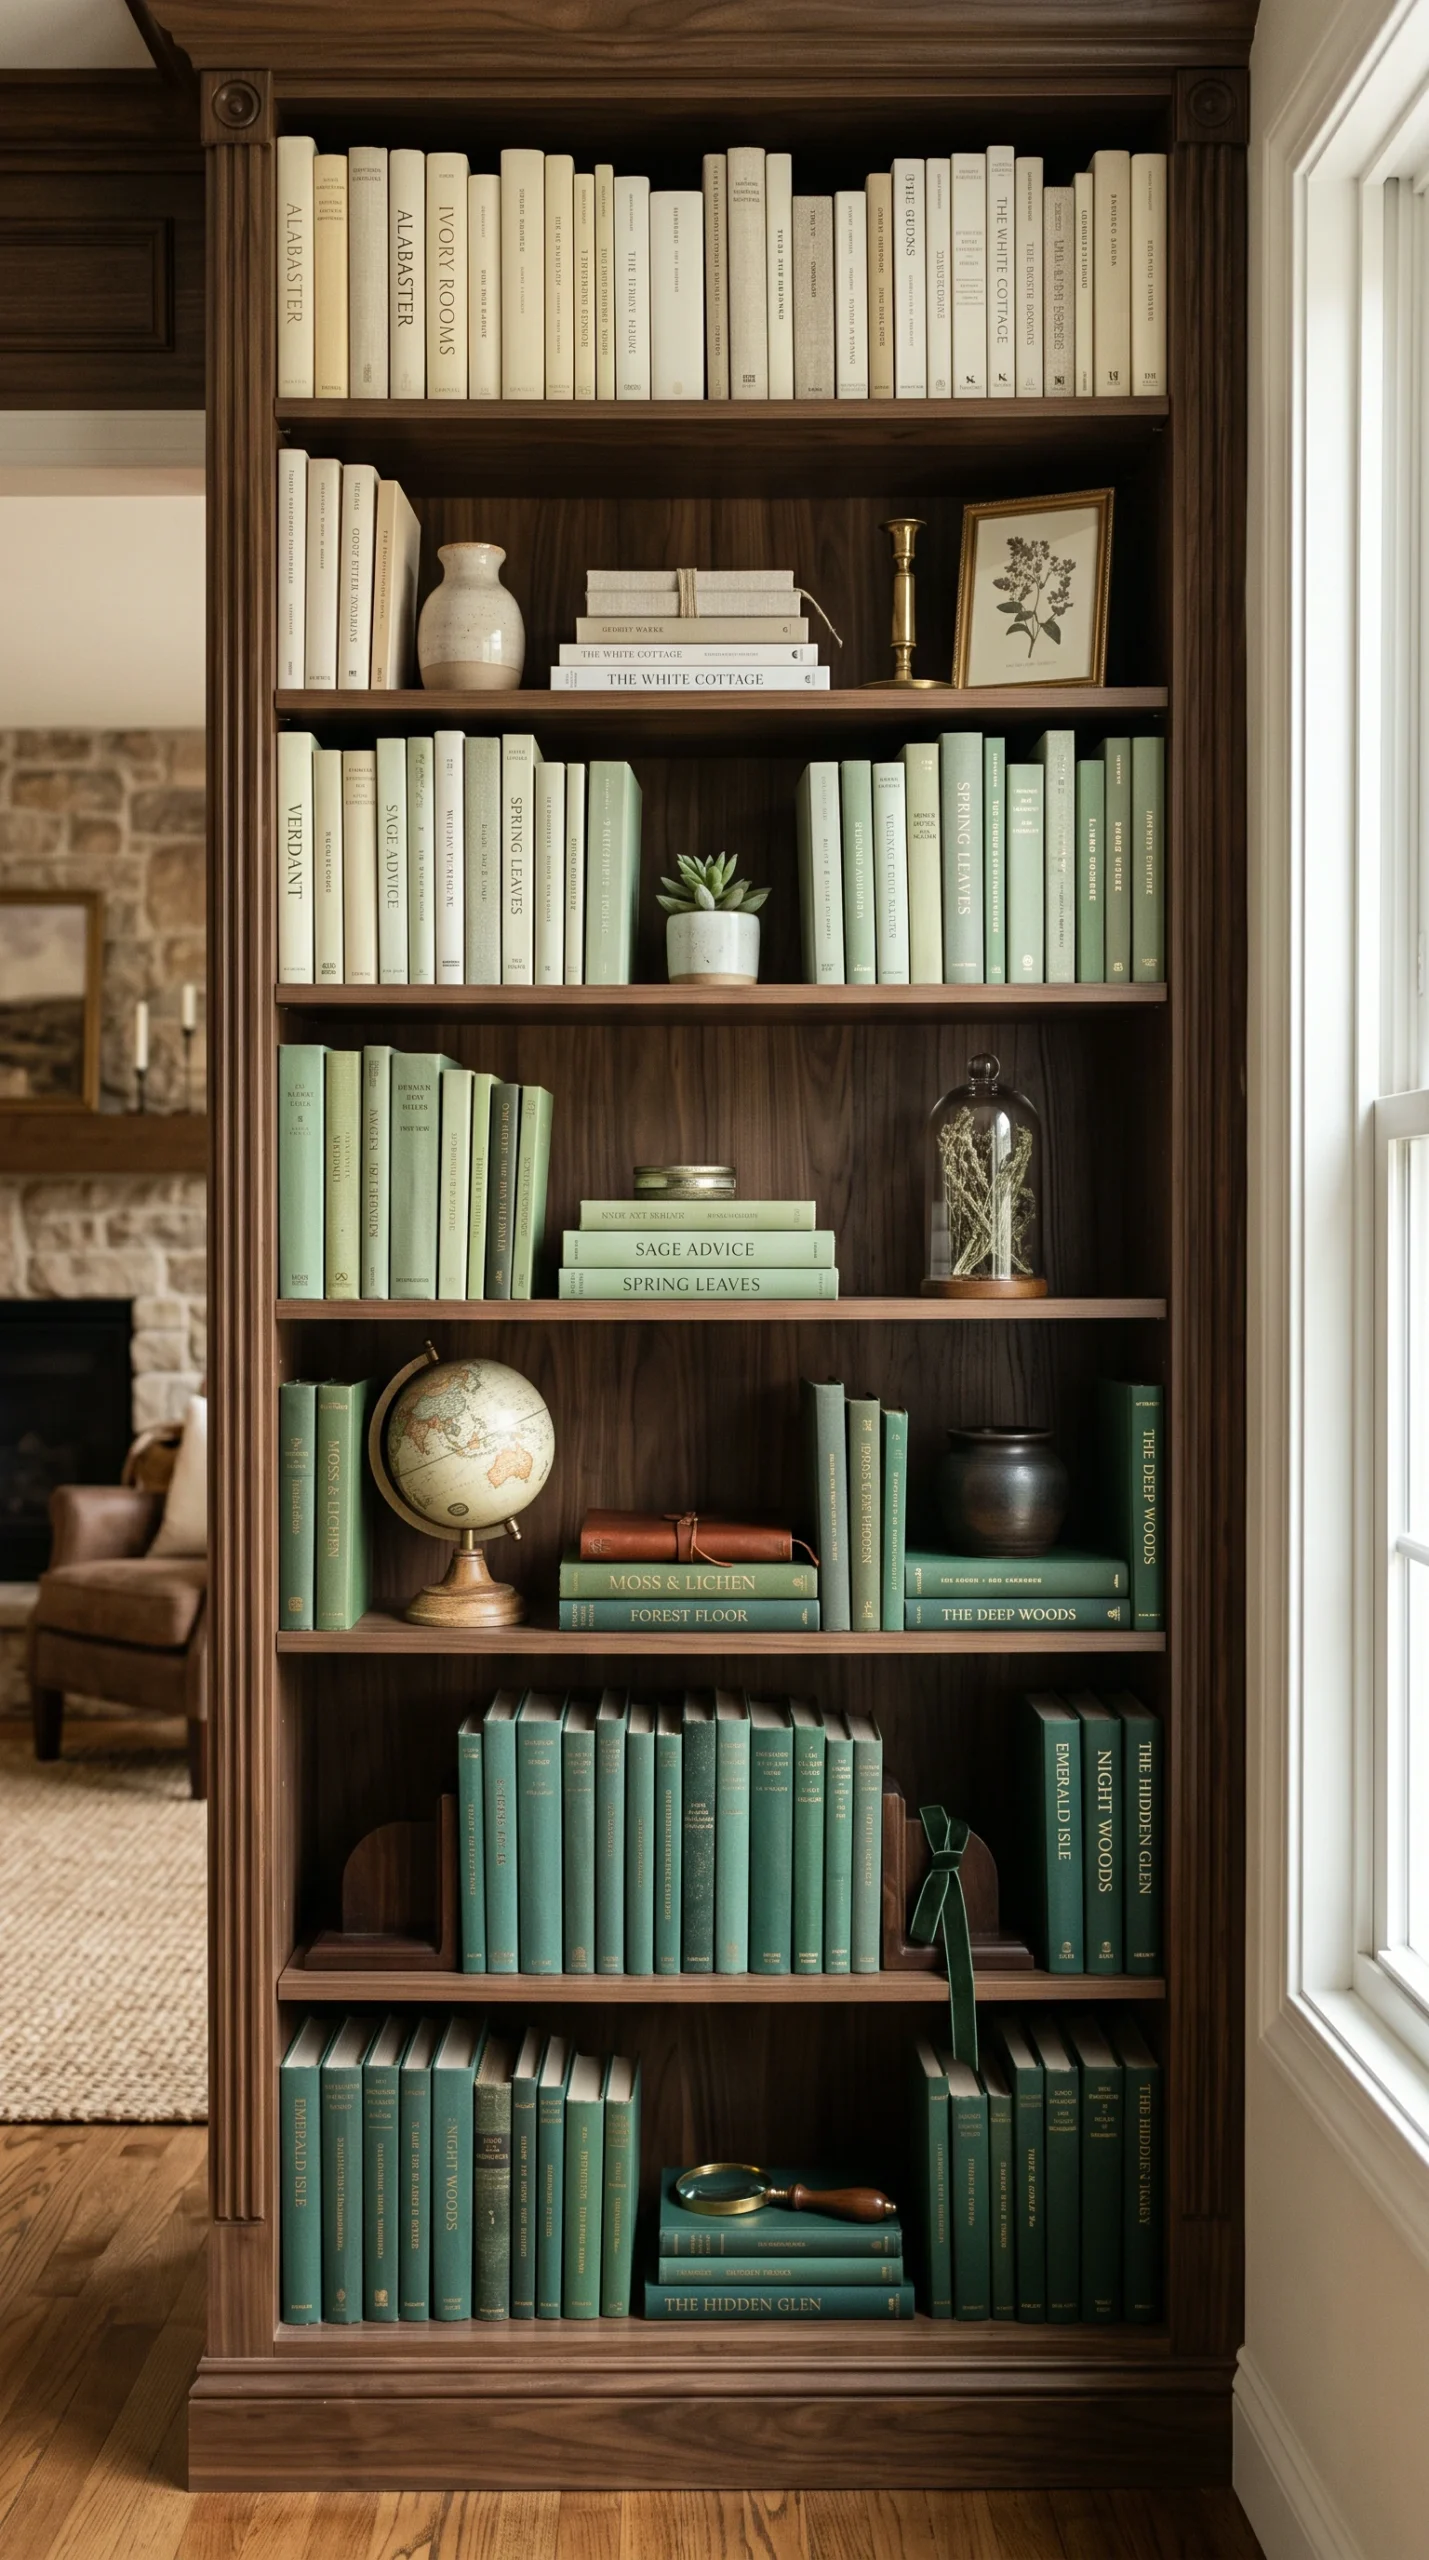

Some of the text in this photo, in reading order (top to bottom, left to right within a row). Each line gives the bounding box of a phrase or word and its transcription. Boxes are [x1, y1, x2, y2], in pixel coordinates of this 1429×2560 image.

[287, 203, 303, 324] ALABASTER
[397, 209, 414, 327] ALABASTER
[438, 206, 455, 356] IVORY ROOMS
[997, 197, 1008, 344] THE WHITE COTTAGE
[581, 650, 683, 659] THE WHITE COTTAGE
[607, 673, 764, 686] THE WHITE COTTAGE
[287, 803, 302, 900] VERDANT
[386, 804, 399, 910] SAGE ADVICE
[510, 797, 522, 915] SPRING LEAVES
[957, 781, 971, 916] SPRING LEAVES
[623, 1277, 761, 1292] SPRING LEAVES
[635, 1242, 755, 1257] SAGE ADVICE
[328, 1440, 340, 1482] MOSS
[328, 1486, 340, 1496] &
[1143, 1429, 1156, 1565] THE DEEP WOODS
[609, 1575, 756, 1590] MOSS & LICHEN
[630, 1610, 748, 1622] FOREST FLOOR
[942, 1608, 1077, 1621] THE DEEP WOODS
[1056, 1743, 1071, 1860] EMERALD ISLE
[1098, 1750, 1112, 1893] NIGHT WOODS
[1139, 1741, 1152, 1894] THE HIDDEN GLEN
[1139, 2084, 1151, 2114] THE
[295, 2098, 307, 2208] EMERALD ISLE
[446, 2125, 458, 2232] NIGHT WOODS
[664, 2298, 822, 2312] THE HIDDEN GLEN
